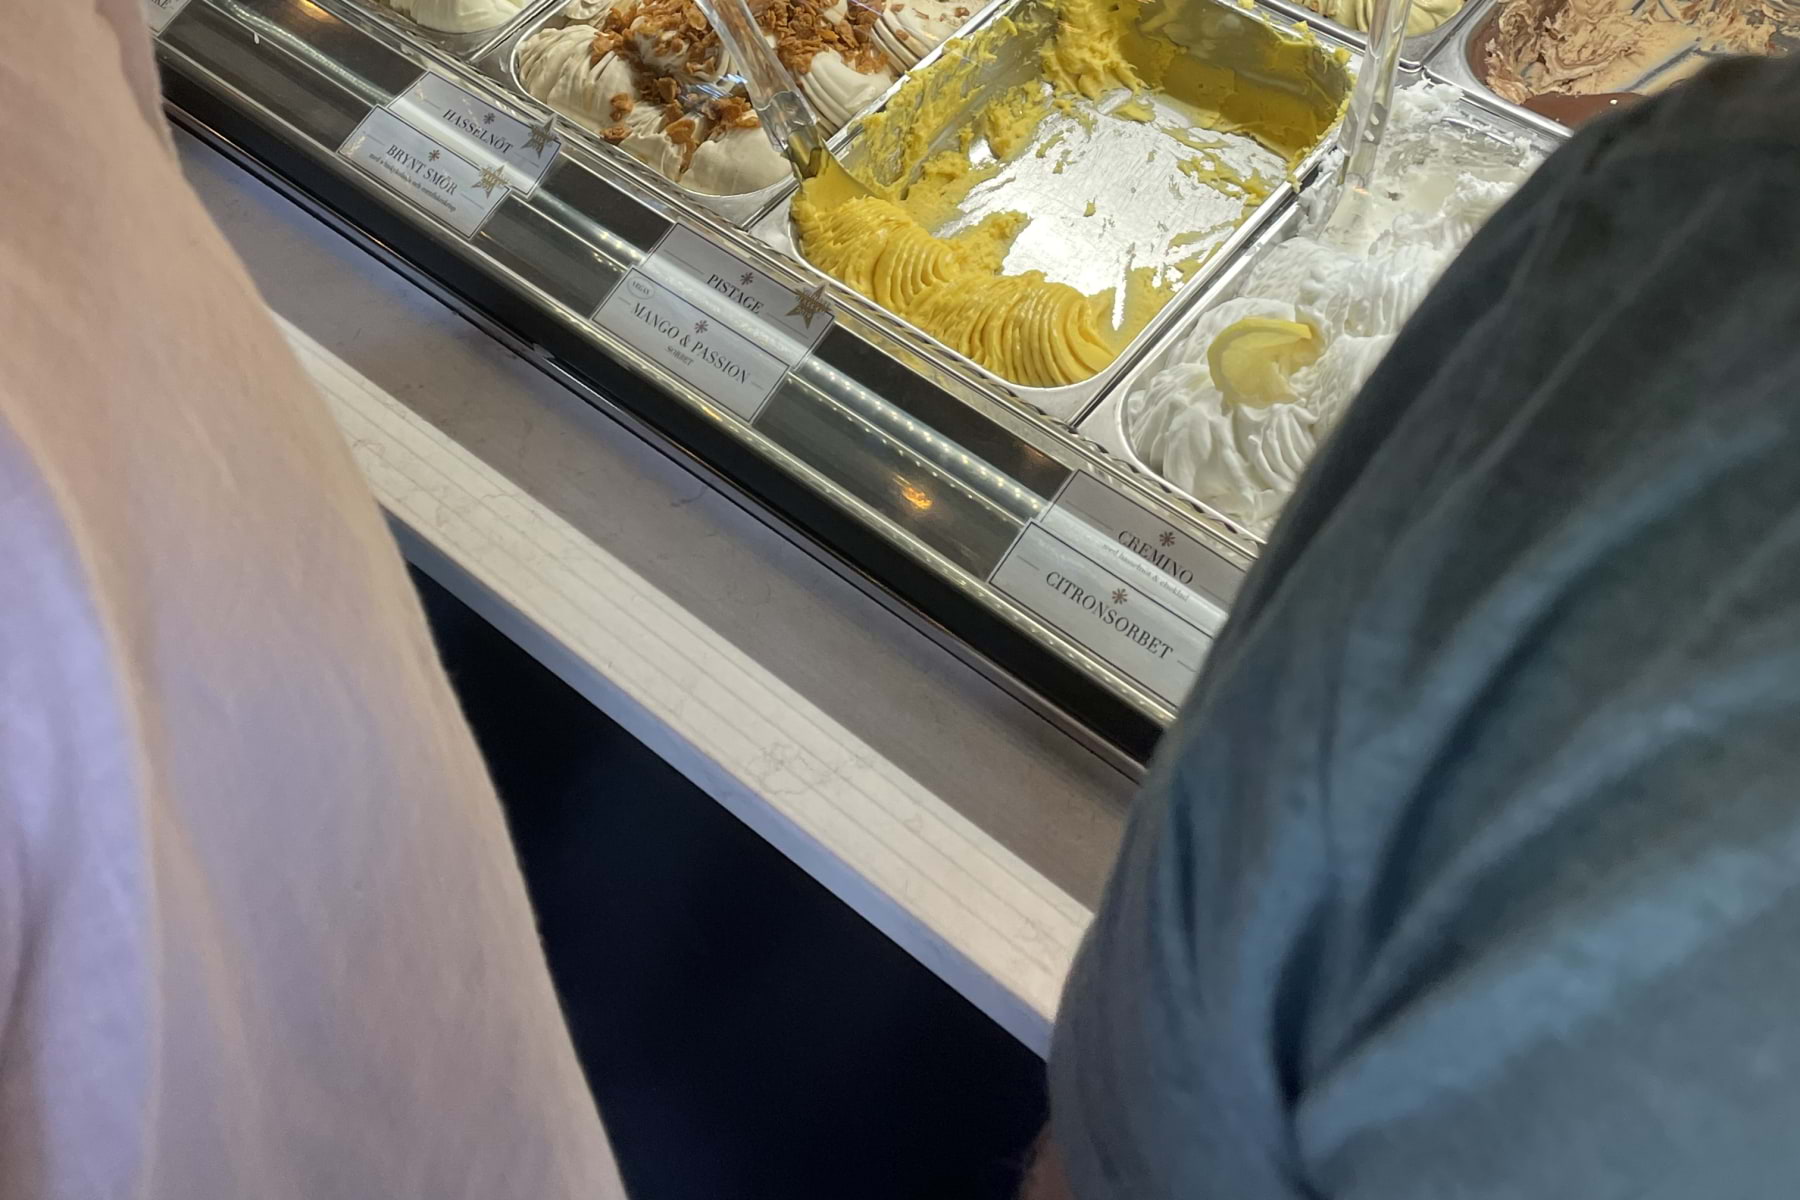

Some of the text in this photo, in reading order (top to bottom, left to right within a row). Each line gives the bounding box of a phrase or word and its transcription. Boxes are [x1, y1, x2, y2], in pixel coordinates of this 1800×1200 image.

[442, 107, 513, 155] HASSELNÖT
[386, 143, 426, 175] BRYNT
[422, 166, 458, 196] SMÖR
[706, 273, 765, 316] PISTAGE
[631, 302, 752, 385] MANGO & PASSION
[665, 345, 694, 366] SORBET
[1117, 529, 1194, 586] CREMINO
[1044, 570, 1175, 661] CITRONSORBET
